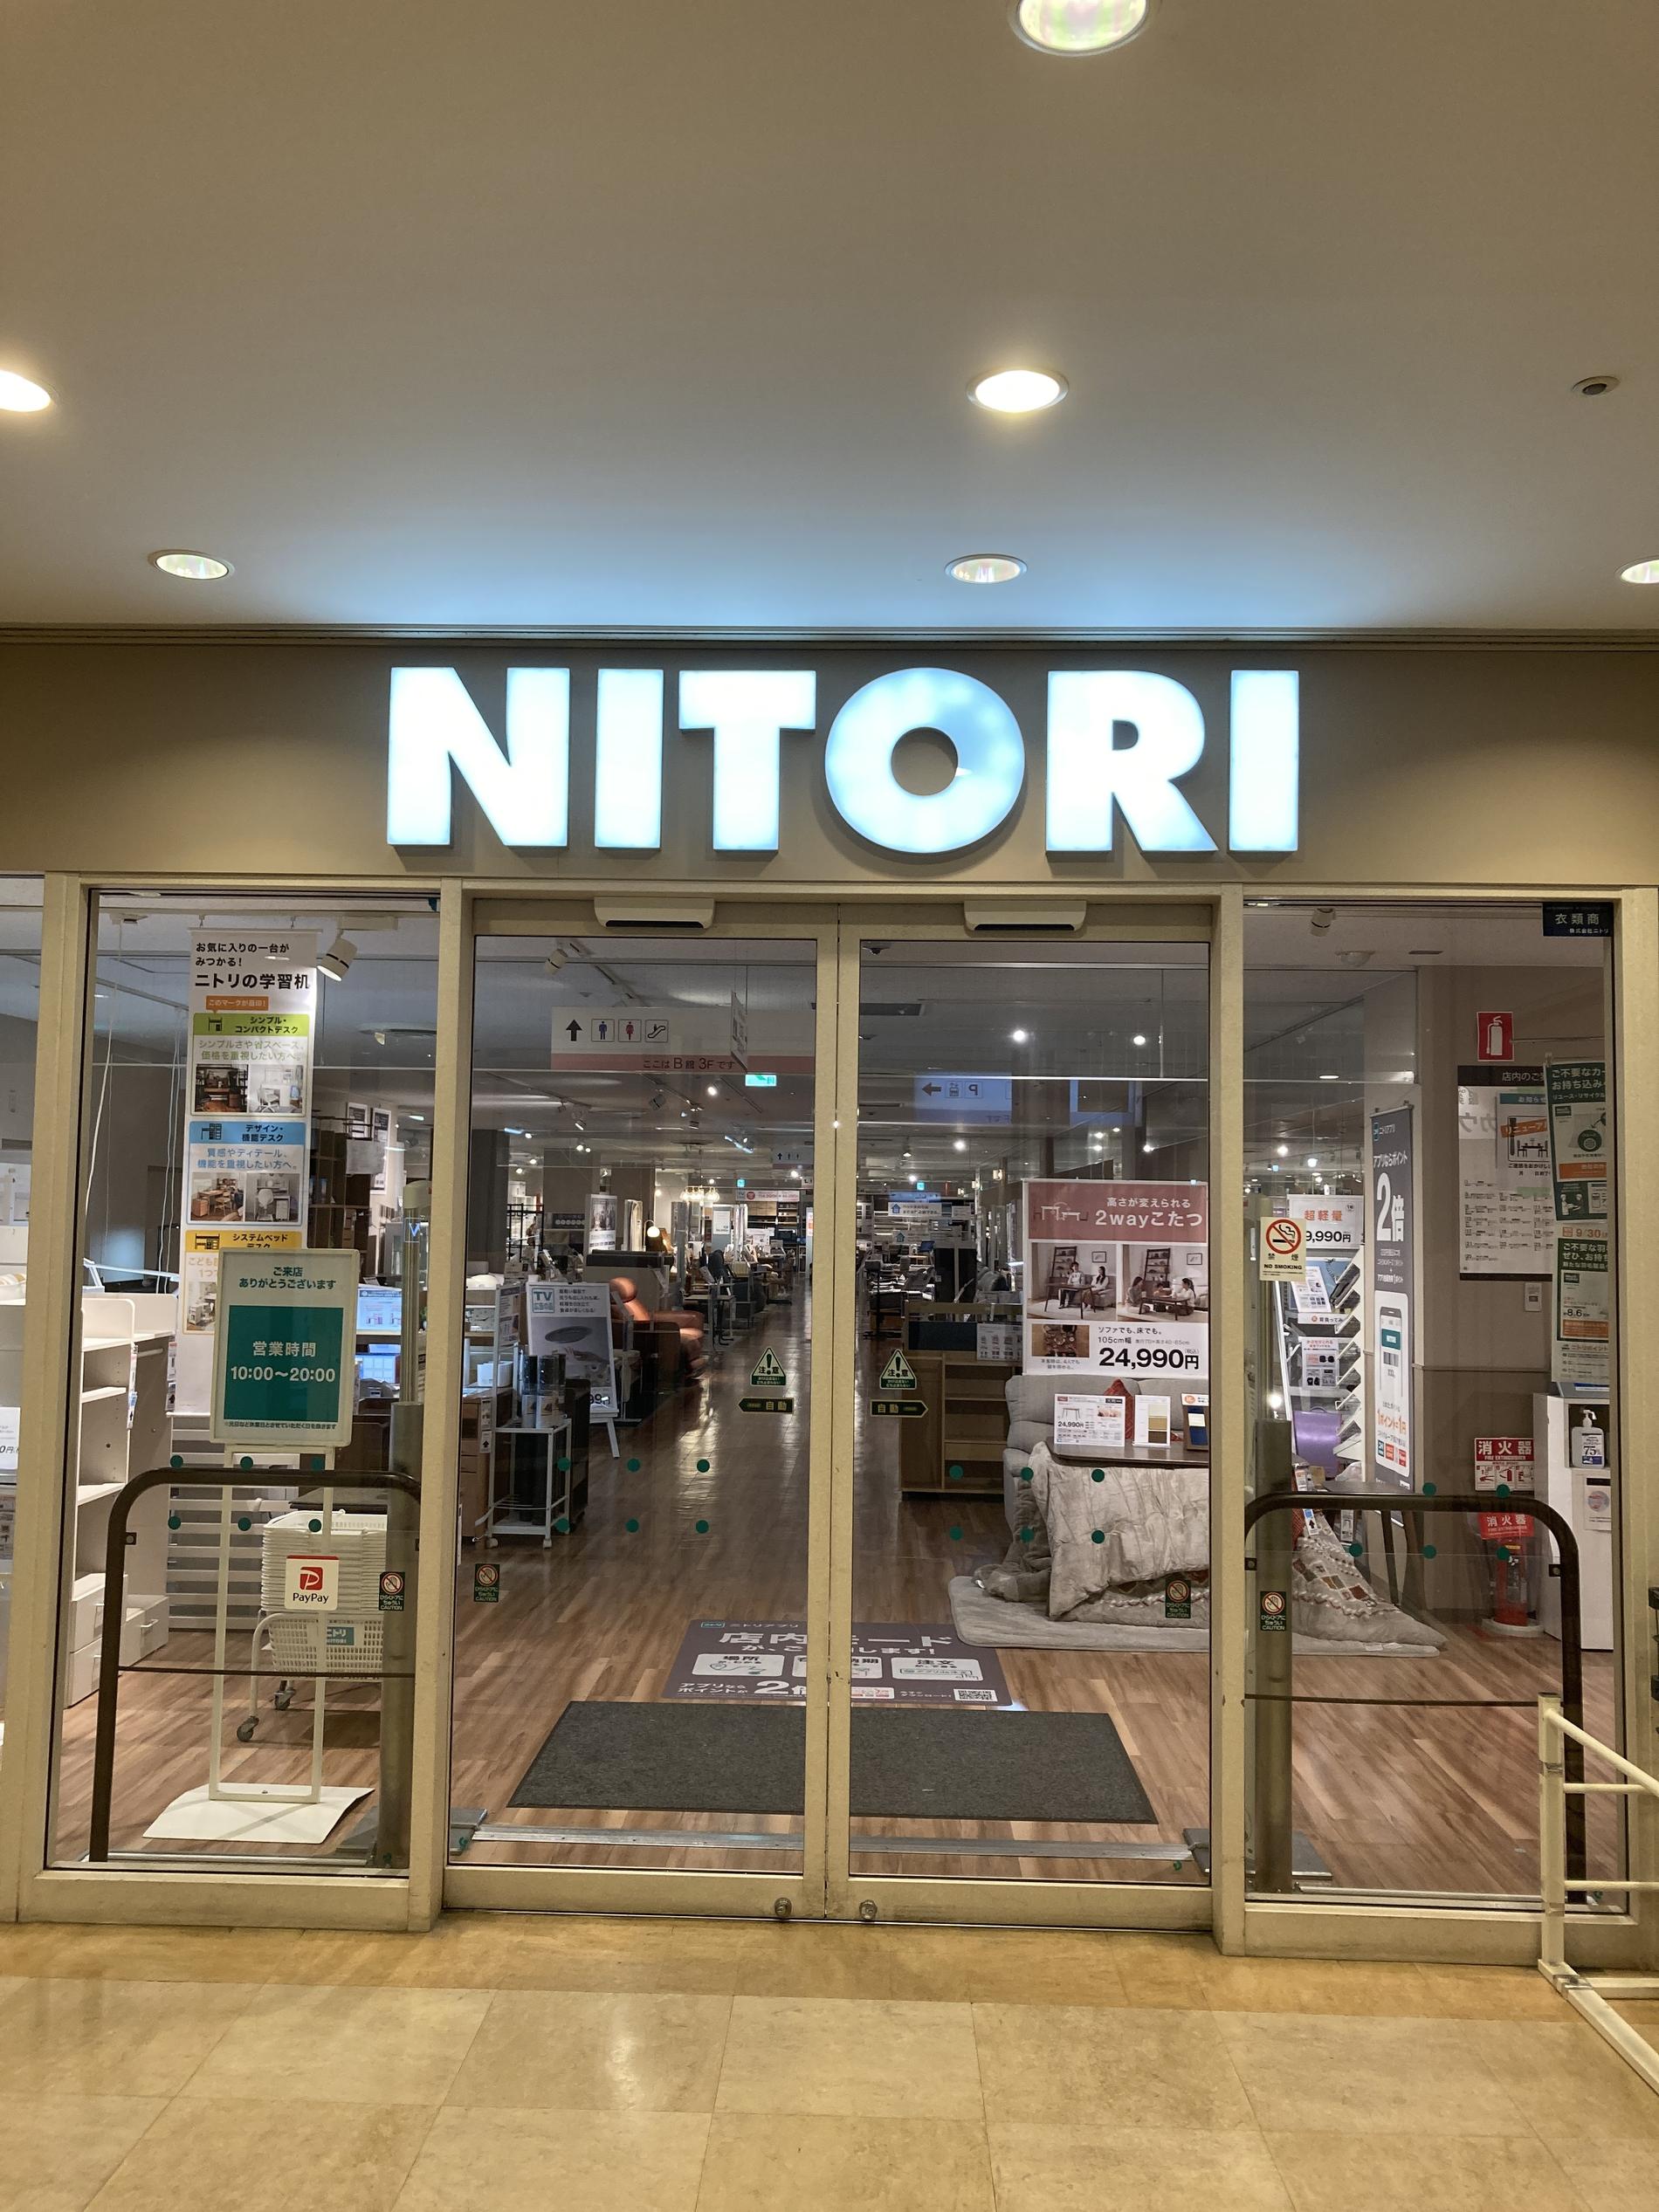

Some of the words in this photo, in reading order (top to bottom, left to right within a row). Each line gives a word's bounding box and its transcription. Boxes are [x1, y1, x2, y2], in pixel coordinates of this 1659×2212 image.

[387, 665, 1299, 853] NITORI
[1554, 913, 1600, 924] 衣類商
[196, 943, 290, 952] お気に入りの一台が
[196, 973, 310, 989] ニトリの学習机
[202, 1051, 300, 1061] 価格を重視したい方へ。
[1552, 1080, 1606, 1090] お持ち込み
[197, 1159, 297, 1169] 機能を重視したい方へ。
[1106, 1197, 1190, 1208] 高さが変えられる
[1377, 1172, 1404, 1241] 2倍
[1096, 1210, 1202, 1228] 2wayこたつ
[1304, 1210, 1342, 1221] 超軽量
[272, 1267, 303, 1276] ご来店
[239, 1278, 336, 1289] ありがとうございます
[533, 1292, 552, 1301] TV
[252, 1341, 316, 1357] 営業時間
[1098, 1347, 1199, 1370] 24,990円
[1478, 1440, 1532, 1455] 消火器
[1487, 1514, 1526, 1527] 消火器
[293, 1593, 329, 1604] PayPay
